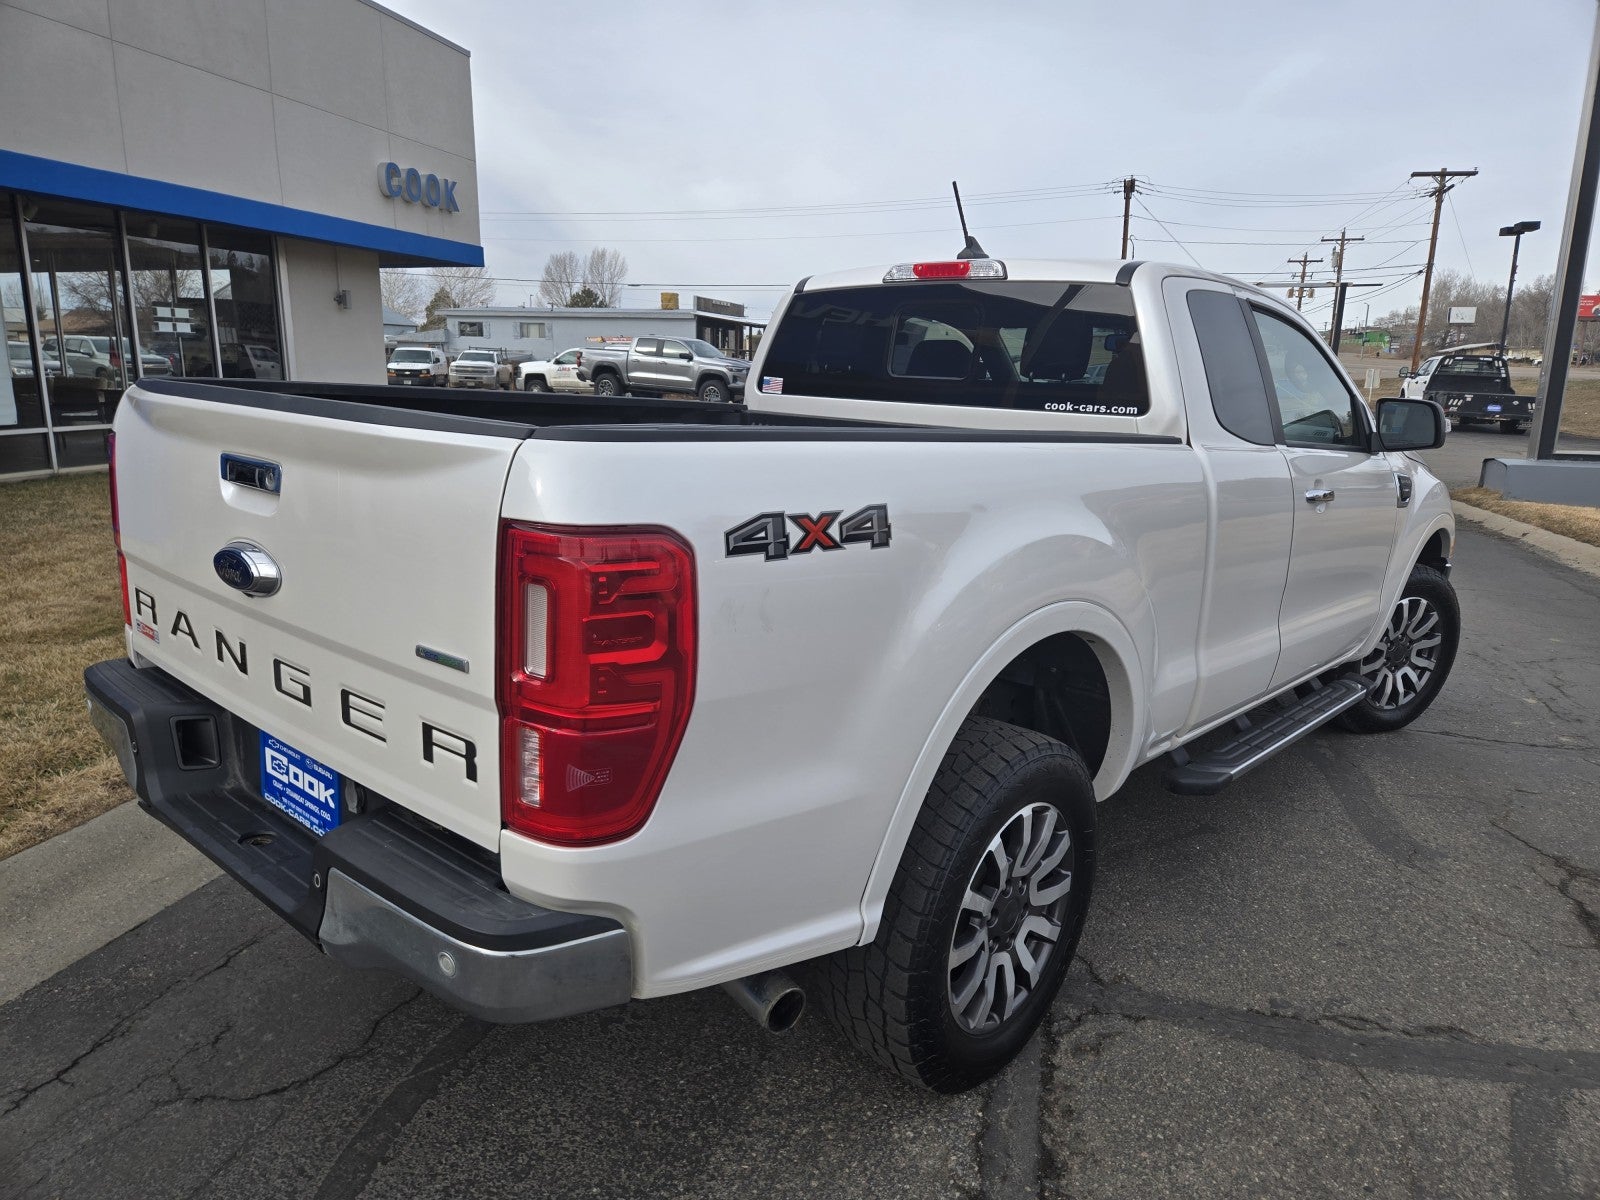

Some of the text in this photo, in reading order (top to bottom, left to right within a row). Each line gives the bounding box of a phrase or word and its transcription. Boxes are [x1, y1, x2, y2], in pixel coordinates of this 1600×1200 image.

[378, 162, 460, 213] COOK
[1045, 402, 1138, 415] cook-cars.com
[135, 587, 478, 784] RANGER
[279, 745, 333, 780] CHEVROLET SUBARU
